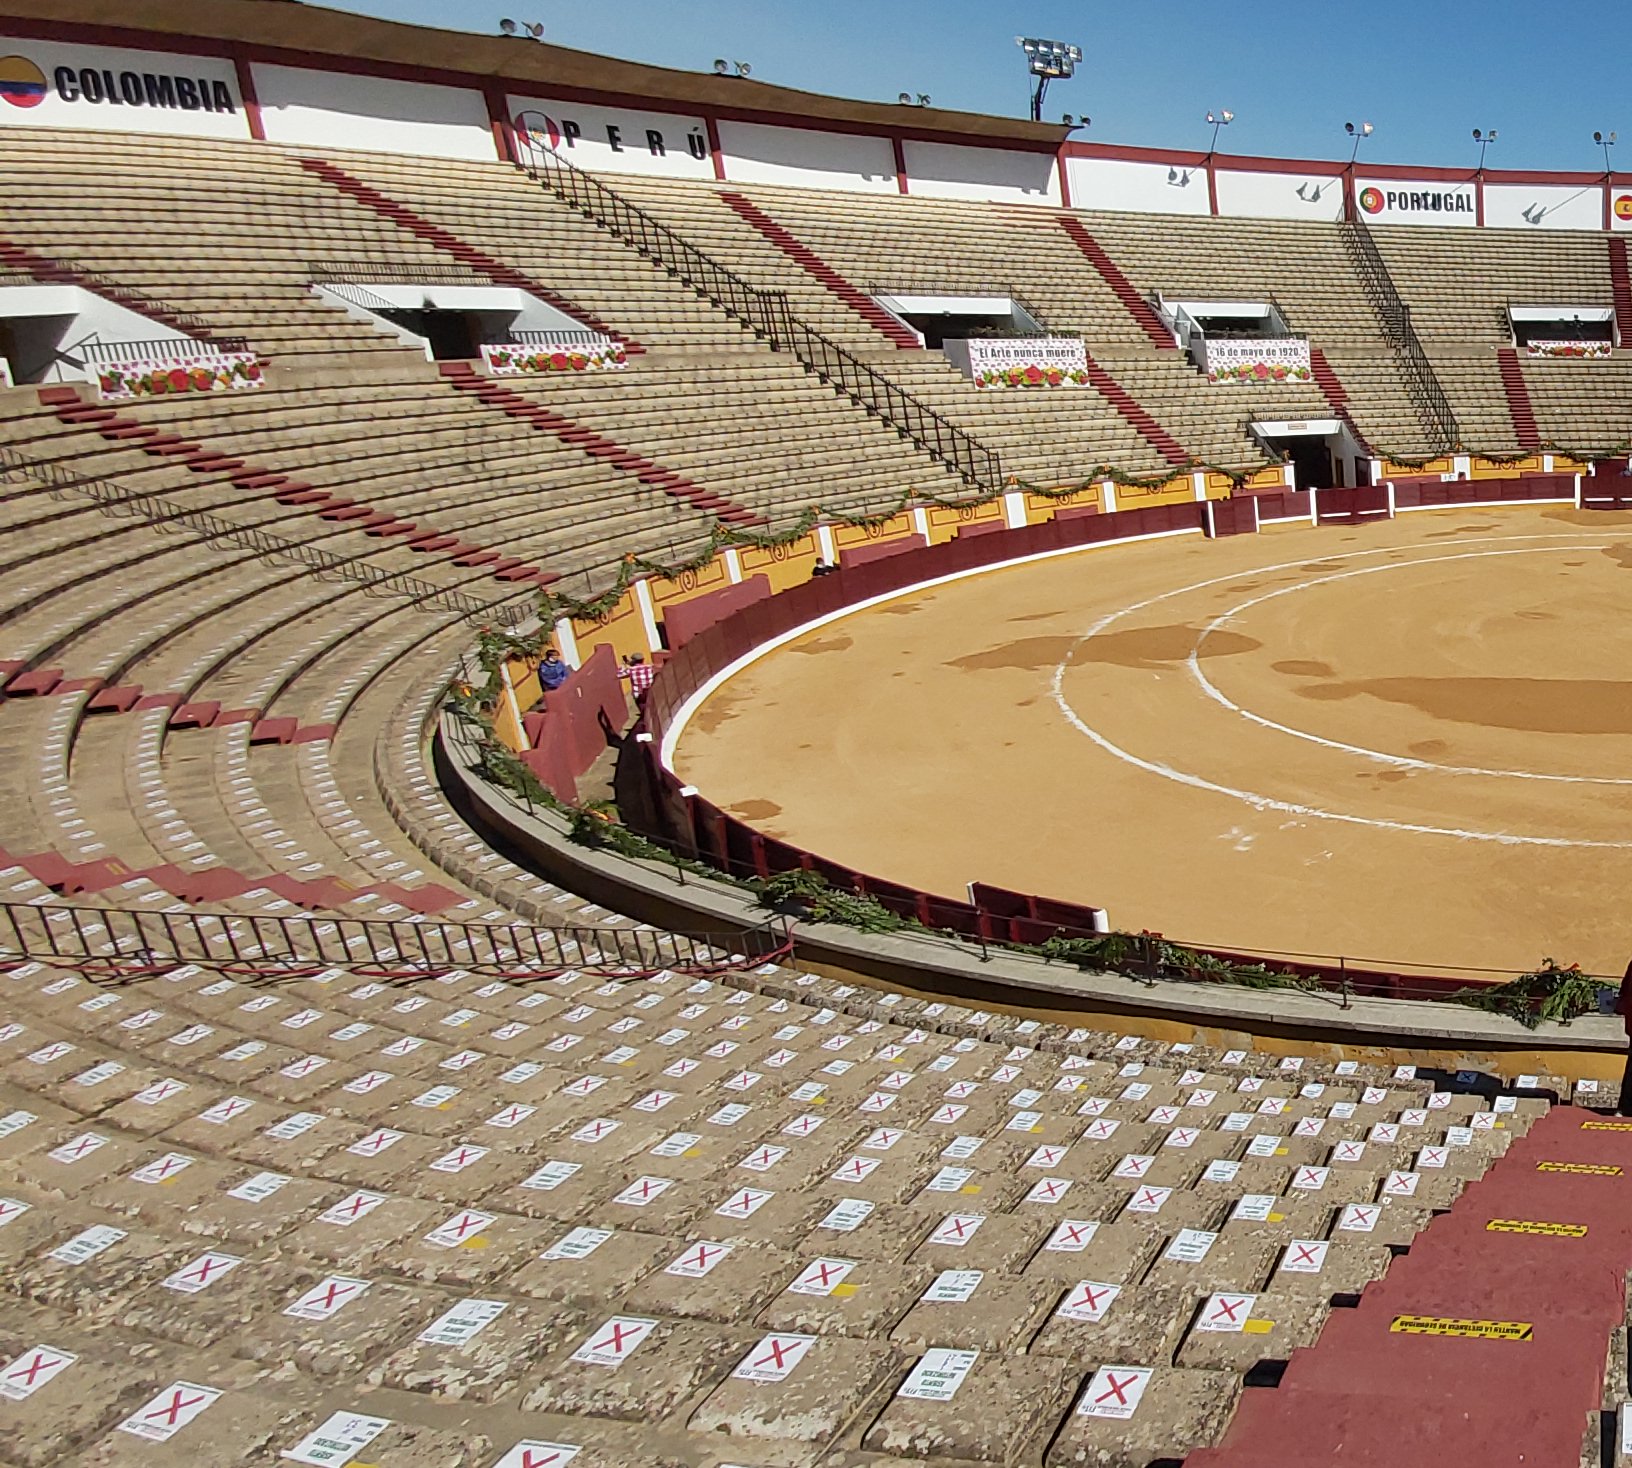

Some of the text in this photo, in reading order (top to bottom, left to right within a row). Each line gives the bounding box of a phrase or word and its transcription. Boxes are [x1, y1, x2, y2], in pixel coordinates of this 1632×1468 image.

[54, 66, 236, 114] COLOMBIA
[1387, 191, 1474, 212] PORTUGAL
[991, 348, 1011, 358] Arte
[1013, 349, 1043, 358] nunca
[1046, 349, 1076, 357] muere
[1216, 348, 1225, 356] 16
[1228, 348, 1238, 356] de
[1241, 348, 1264, 357] mayo
[1266, 348, 1276, 356] de
